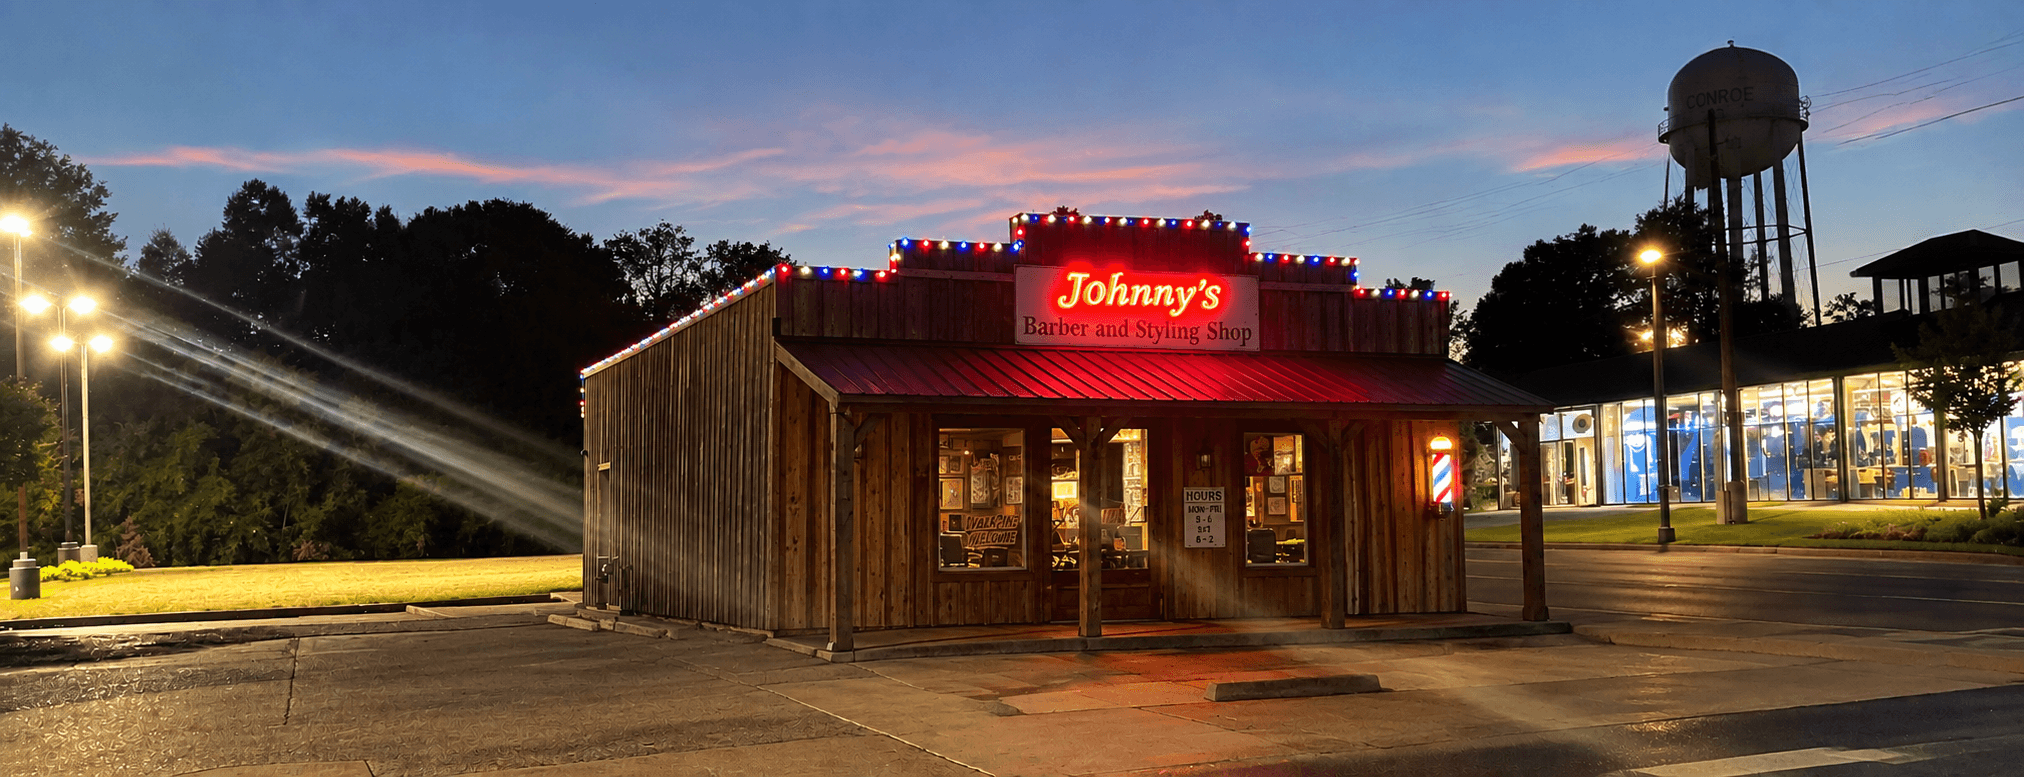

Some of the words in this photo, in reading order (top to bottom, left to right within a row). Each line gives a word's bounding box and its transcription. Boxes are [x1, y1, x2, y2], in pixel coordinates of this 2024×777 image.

[1685, 86, 1754, 110] CONROE
[1058, 272, 1221, 317] Johnny’s
[1023, 316, 1089, 337] Barber
[1095, 319, 1130, 338] and
[1135, 320, 1200, 345] Styling
[1206, 321, 1253, 347] Shop
[1186, 491, 1222, 501] HOURS
